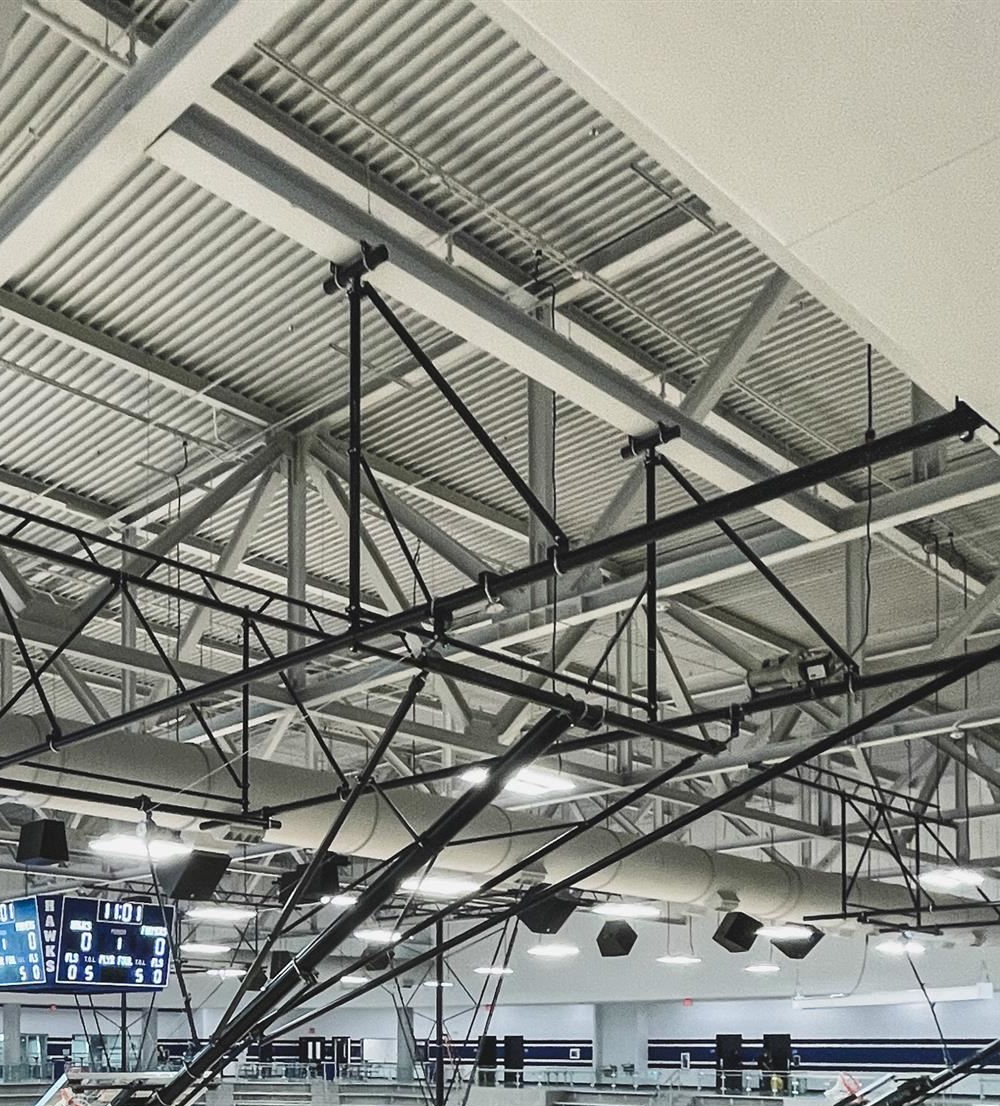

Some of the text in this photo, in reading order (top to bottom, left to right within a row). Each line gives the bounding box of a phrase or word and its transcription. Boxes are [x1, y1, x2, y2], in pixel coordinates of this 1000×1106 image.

[104, 902, 142, 922] 11:01
[27, 931, 37, 950] 0
[43, 900, 57, 973] HAWKS
[80, 931, 93, 952] 0
[154, 937, 166, 956] 0
[67, 964, 78, 980] 0
[152, 968, 163, 984] 0
